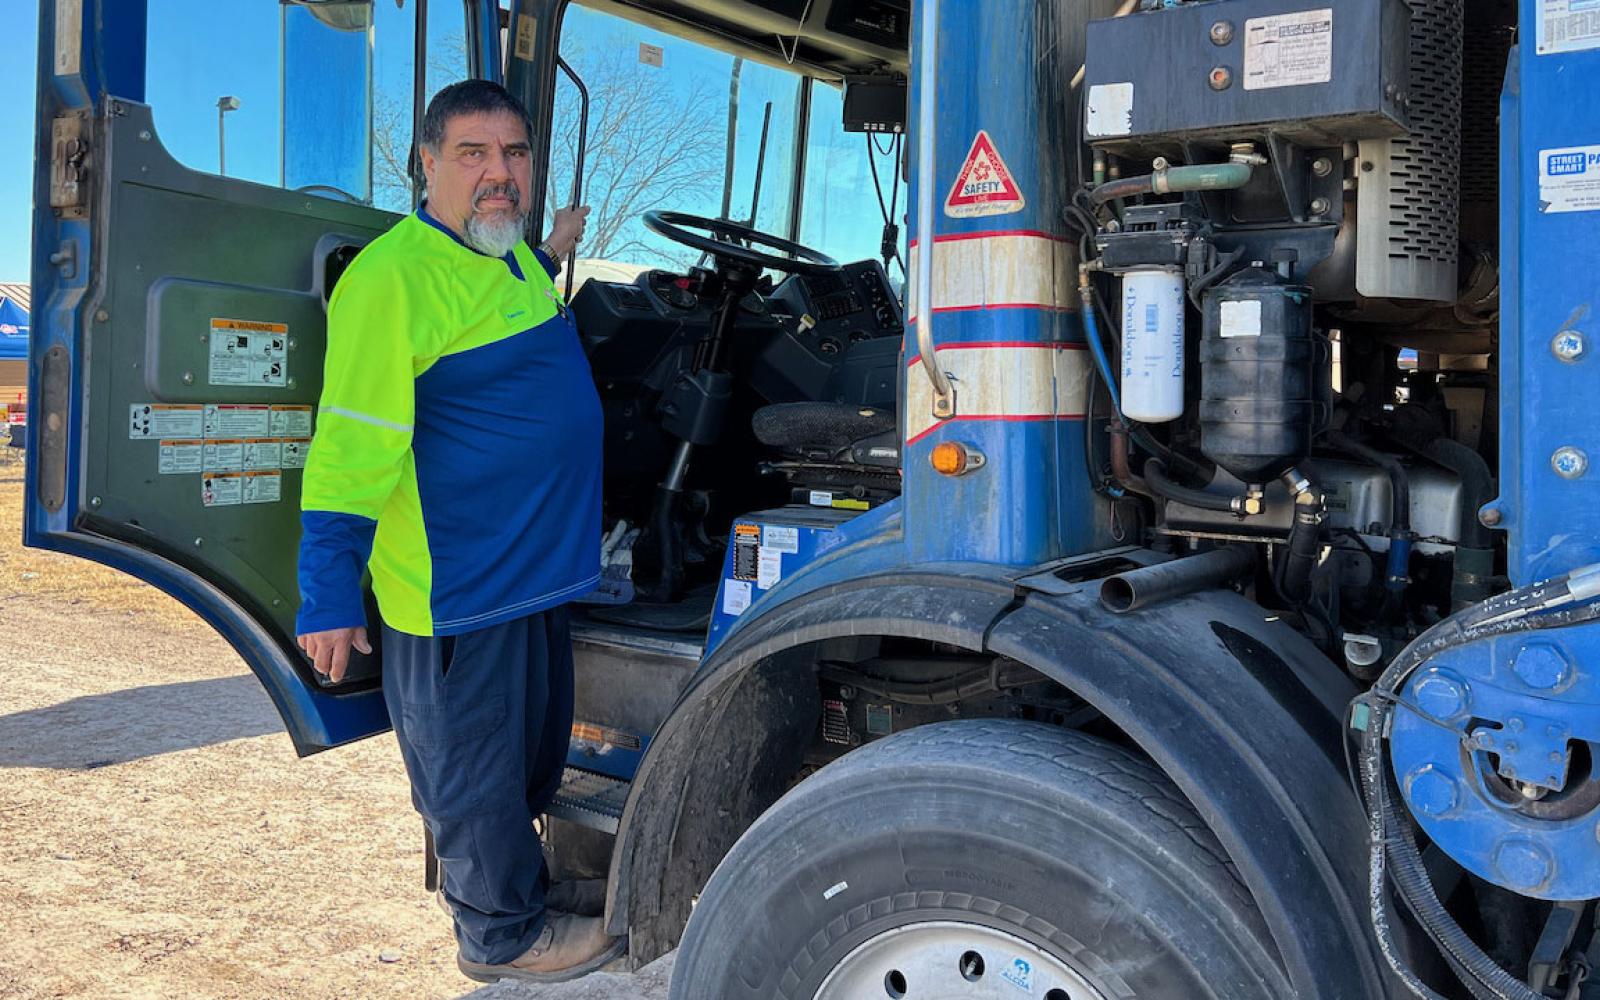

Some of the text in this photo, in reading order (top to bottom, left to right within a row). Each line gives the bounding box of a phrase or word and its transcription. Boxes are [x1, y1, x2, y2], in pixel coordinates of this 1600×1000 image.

[1550, 155, 1583, 164] STREET
[1550, 164, 1583, 173] SMART
[964, 181, 1000, 194] SAFETY
[238, 321, 273, 332] WARNING
